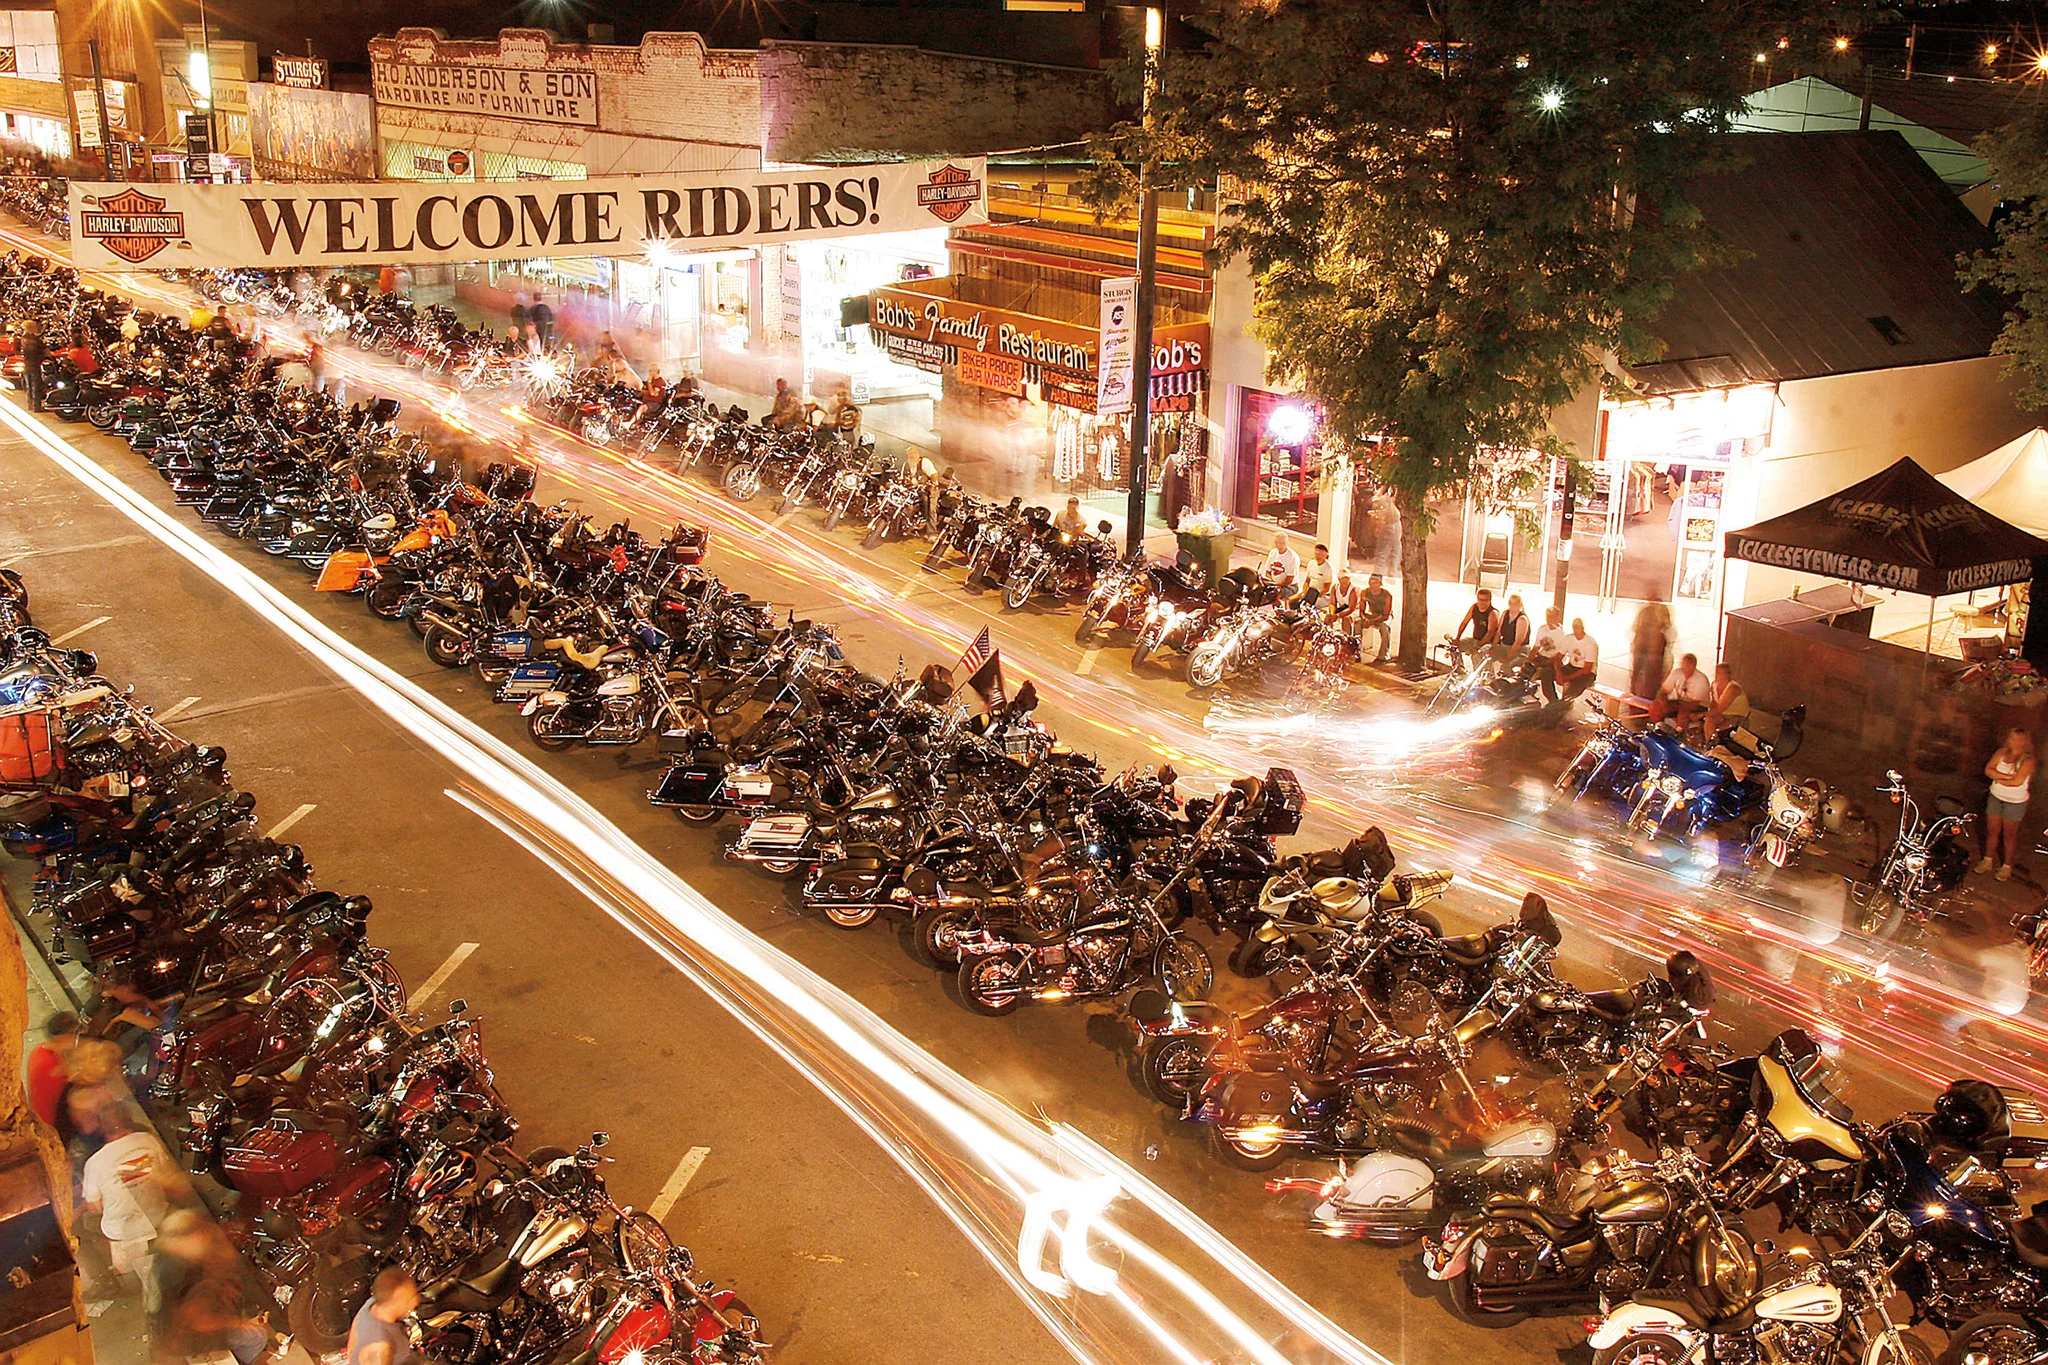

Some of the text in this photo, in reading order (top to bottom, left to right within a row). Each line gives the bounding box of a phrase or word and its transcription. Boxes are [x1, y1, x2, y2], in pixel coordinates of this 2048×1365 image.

[275, 59, 321, 85] STURGIS
[285, 76, 313, 88] OUTPOST
[519, 73, 533, 95] &
[546, 73, 592, 99] SON
[376, 85, 580, 119] HARDWARE AND FURNITURE
[935, 171, 966, 183] MOTOR
[109, 195, 157, 212] MOTOR
[921, 184, 978, 201] HARLEY-DAVIDSON
[240, 176, 880, 256] WELCOME RIDERS!
[934, 201, 966, 218] COMPANY
[88, 216, 179, 233] HARLEY-DAVIDSON
[110, 237, 159, 258] COMPANY
[1103, 288, 1132, 298] STURGIS
[876, 297, 916, 331] Bob's
[924, 300, 988, 352] Family
[999, 323, 1091, 372] Restaurant
[962, 351, 987, 369] BIKER
[989, 358, 1019, 376] PROOF
[961, 366, 1018, 391] HAIR WRAPS
[1738, 539, 1919, 589] ICICLESEYEWEAR.COM
